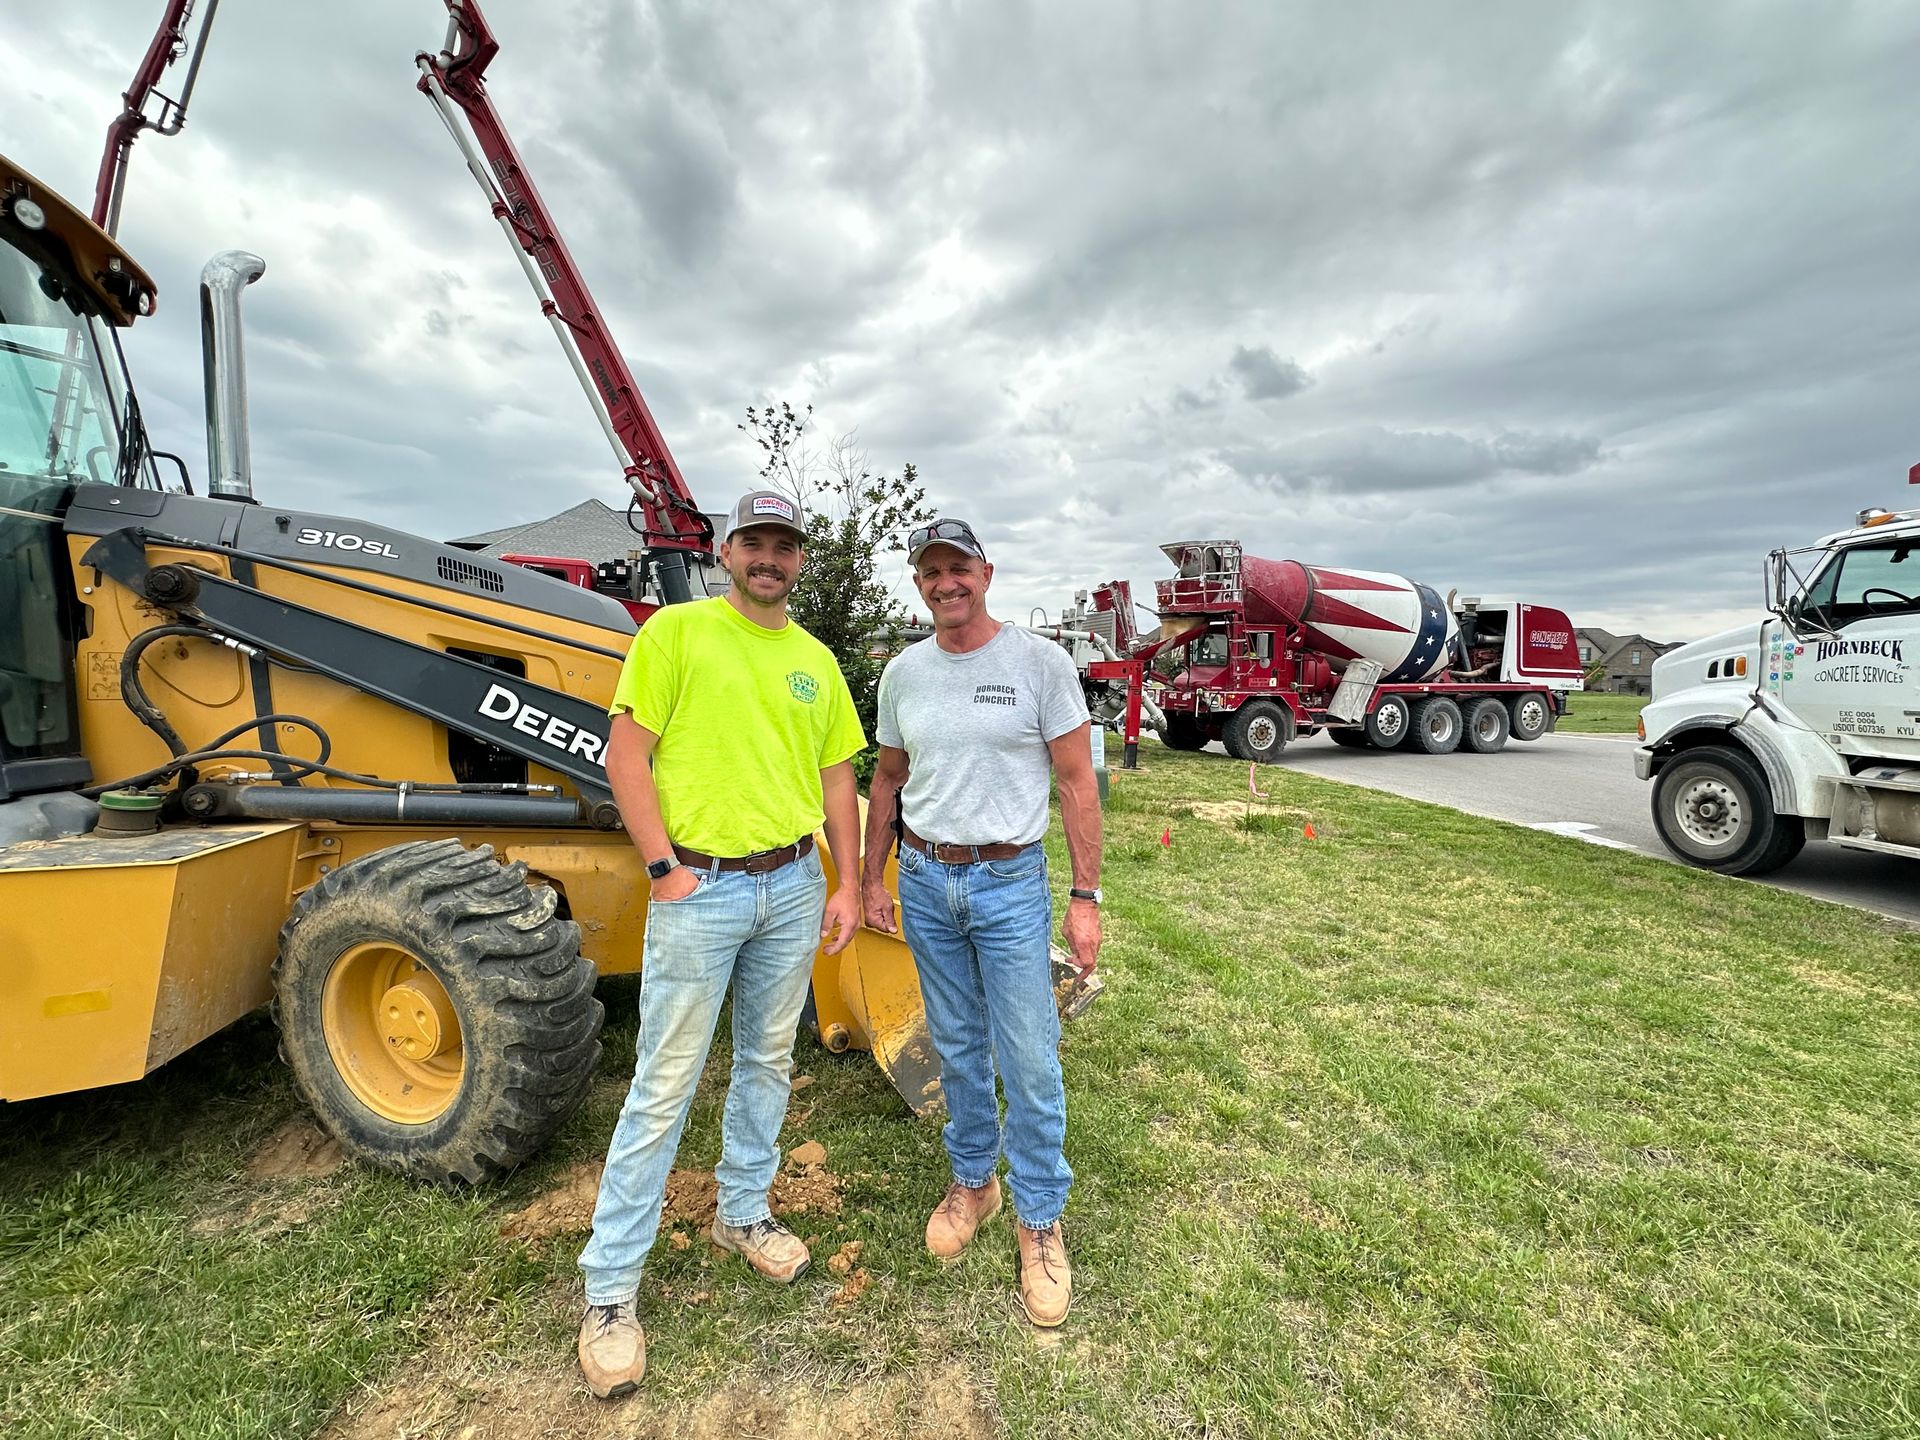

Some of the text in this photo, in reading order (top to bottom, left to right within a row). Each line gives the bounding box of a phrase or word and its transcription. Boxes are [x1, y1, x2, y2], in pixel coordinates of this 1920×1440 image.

[755, 499, 791, 510] CONCRETE
[297, 528, 399, 559] 310SL
[1530, 630, 1569, 644] CONCRETE
[1816, 640, 1903, 662] HORNBECK
[1814, 665, 1904, 683] CONCRETE SERVICES
[975, 684, 1016, 695] HORNBECK
[973, 695, 1017, 706] CONCRETE
[478, 683, 609, 767] DEER
[1833, 724, 1855, 732] USDOT
[1897, 727, 1914, 735] KYU
